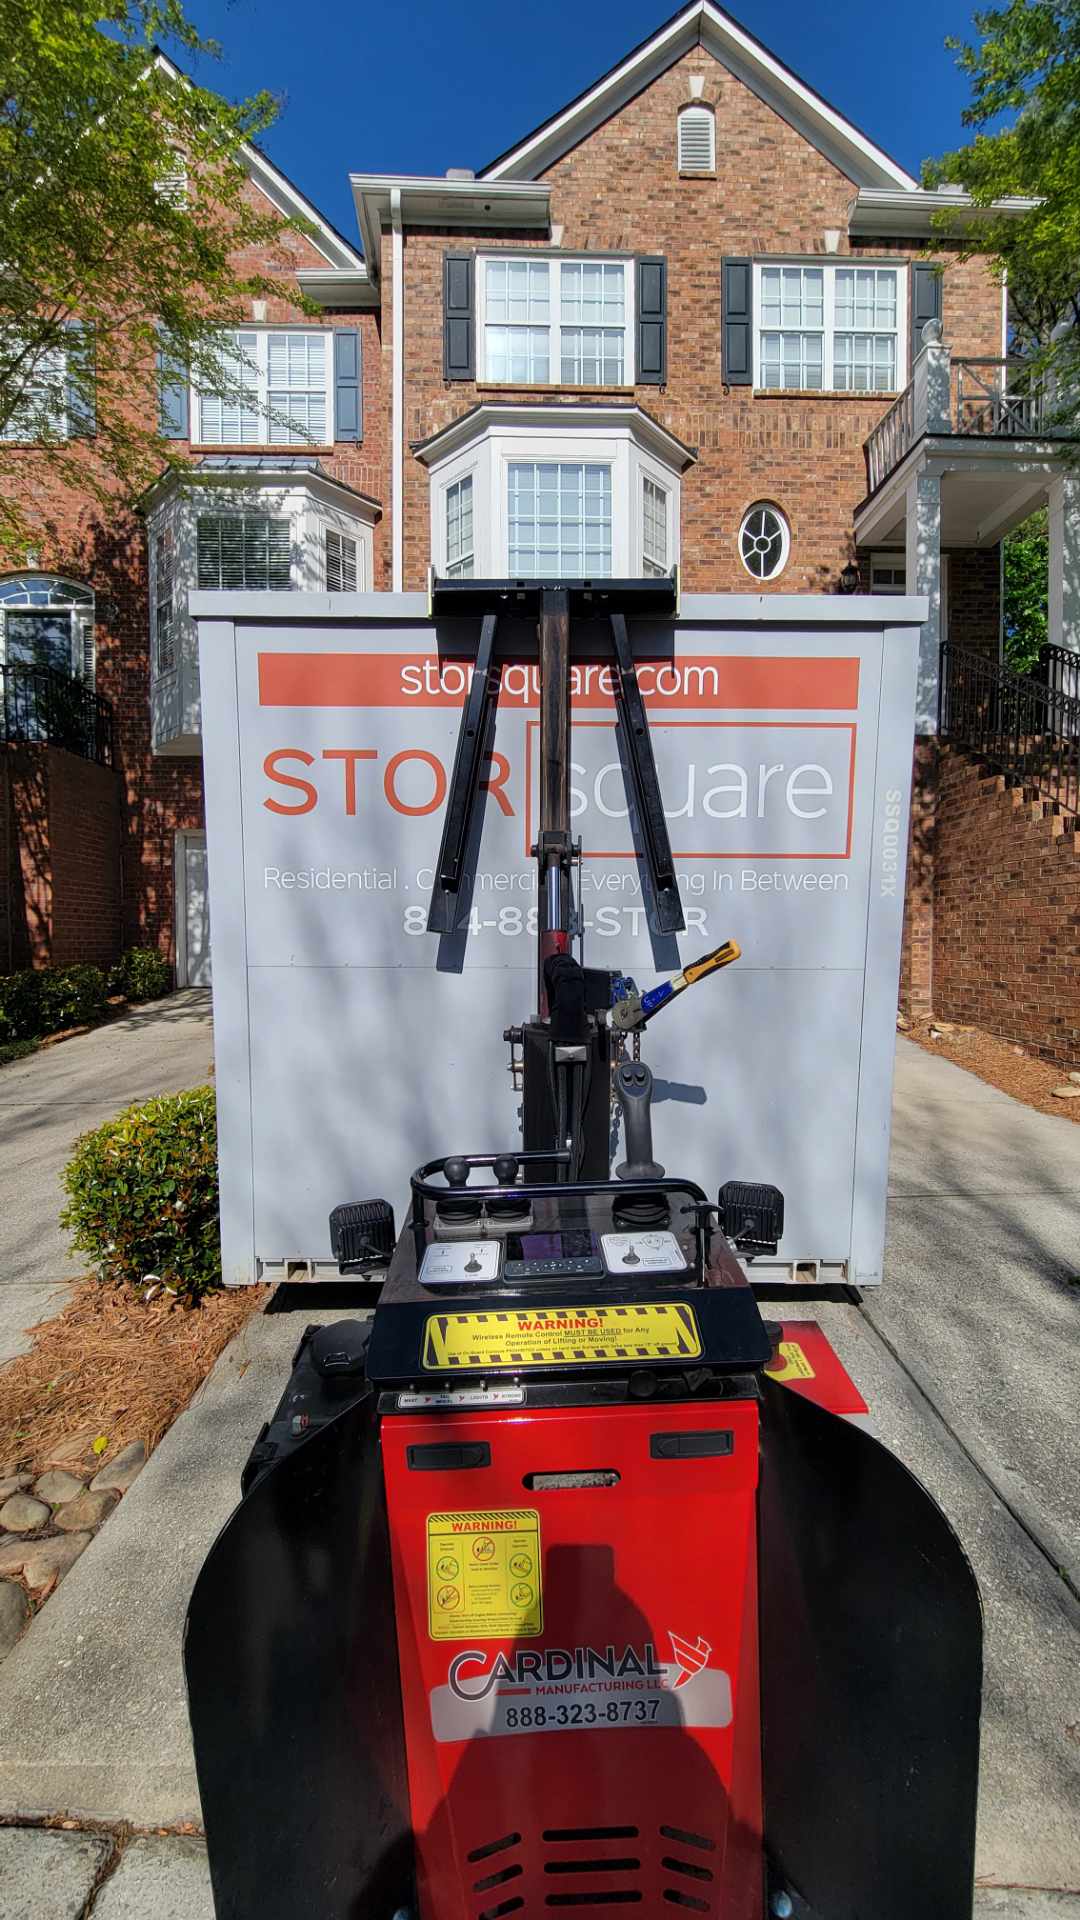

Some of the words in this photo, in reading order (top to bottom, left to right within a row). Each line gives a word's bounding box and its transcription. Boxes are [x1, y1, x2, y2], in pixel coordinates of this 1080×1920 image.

[263, 748, 516, 817] STOR
[264, 867, 397, 889] Residential
[713, 870, 733, 891] In
[741, 869, 849, 891] Between
[517, 1318, 604, 1331] WARNING!
[472, 1333, 504, 1341] Wireless
[505, 1338, 542, 1346] Operation
[552, 1337, 576, 1345] Lifting
[588, 1335, 617, 1343] Moving!
[452, 1520, 518, 1532] WARNING!
[449, 1644, 668, 1701] CARDINAL
[535, 1680, 644, 1695] MANUFACTURING
[647, 1680, 669, 1690] LLC
[506, 1699, 660, 1728] 888-323-8737
